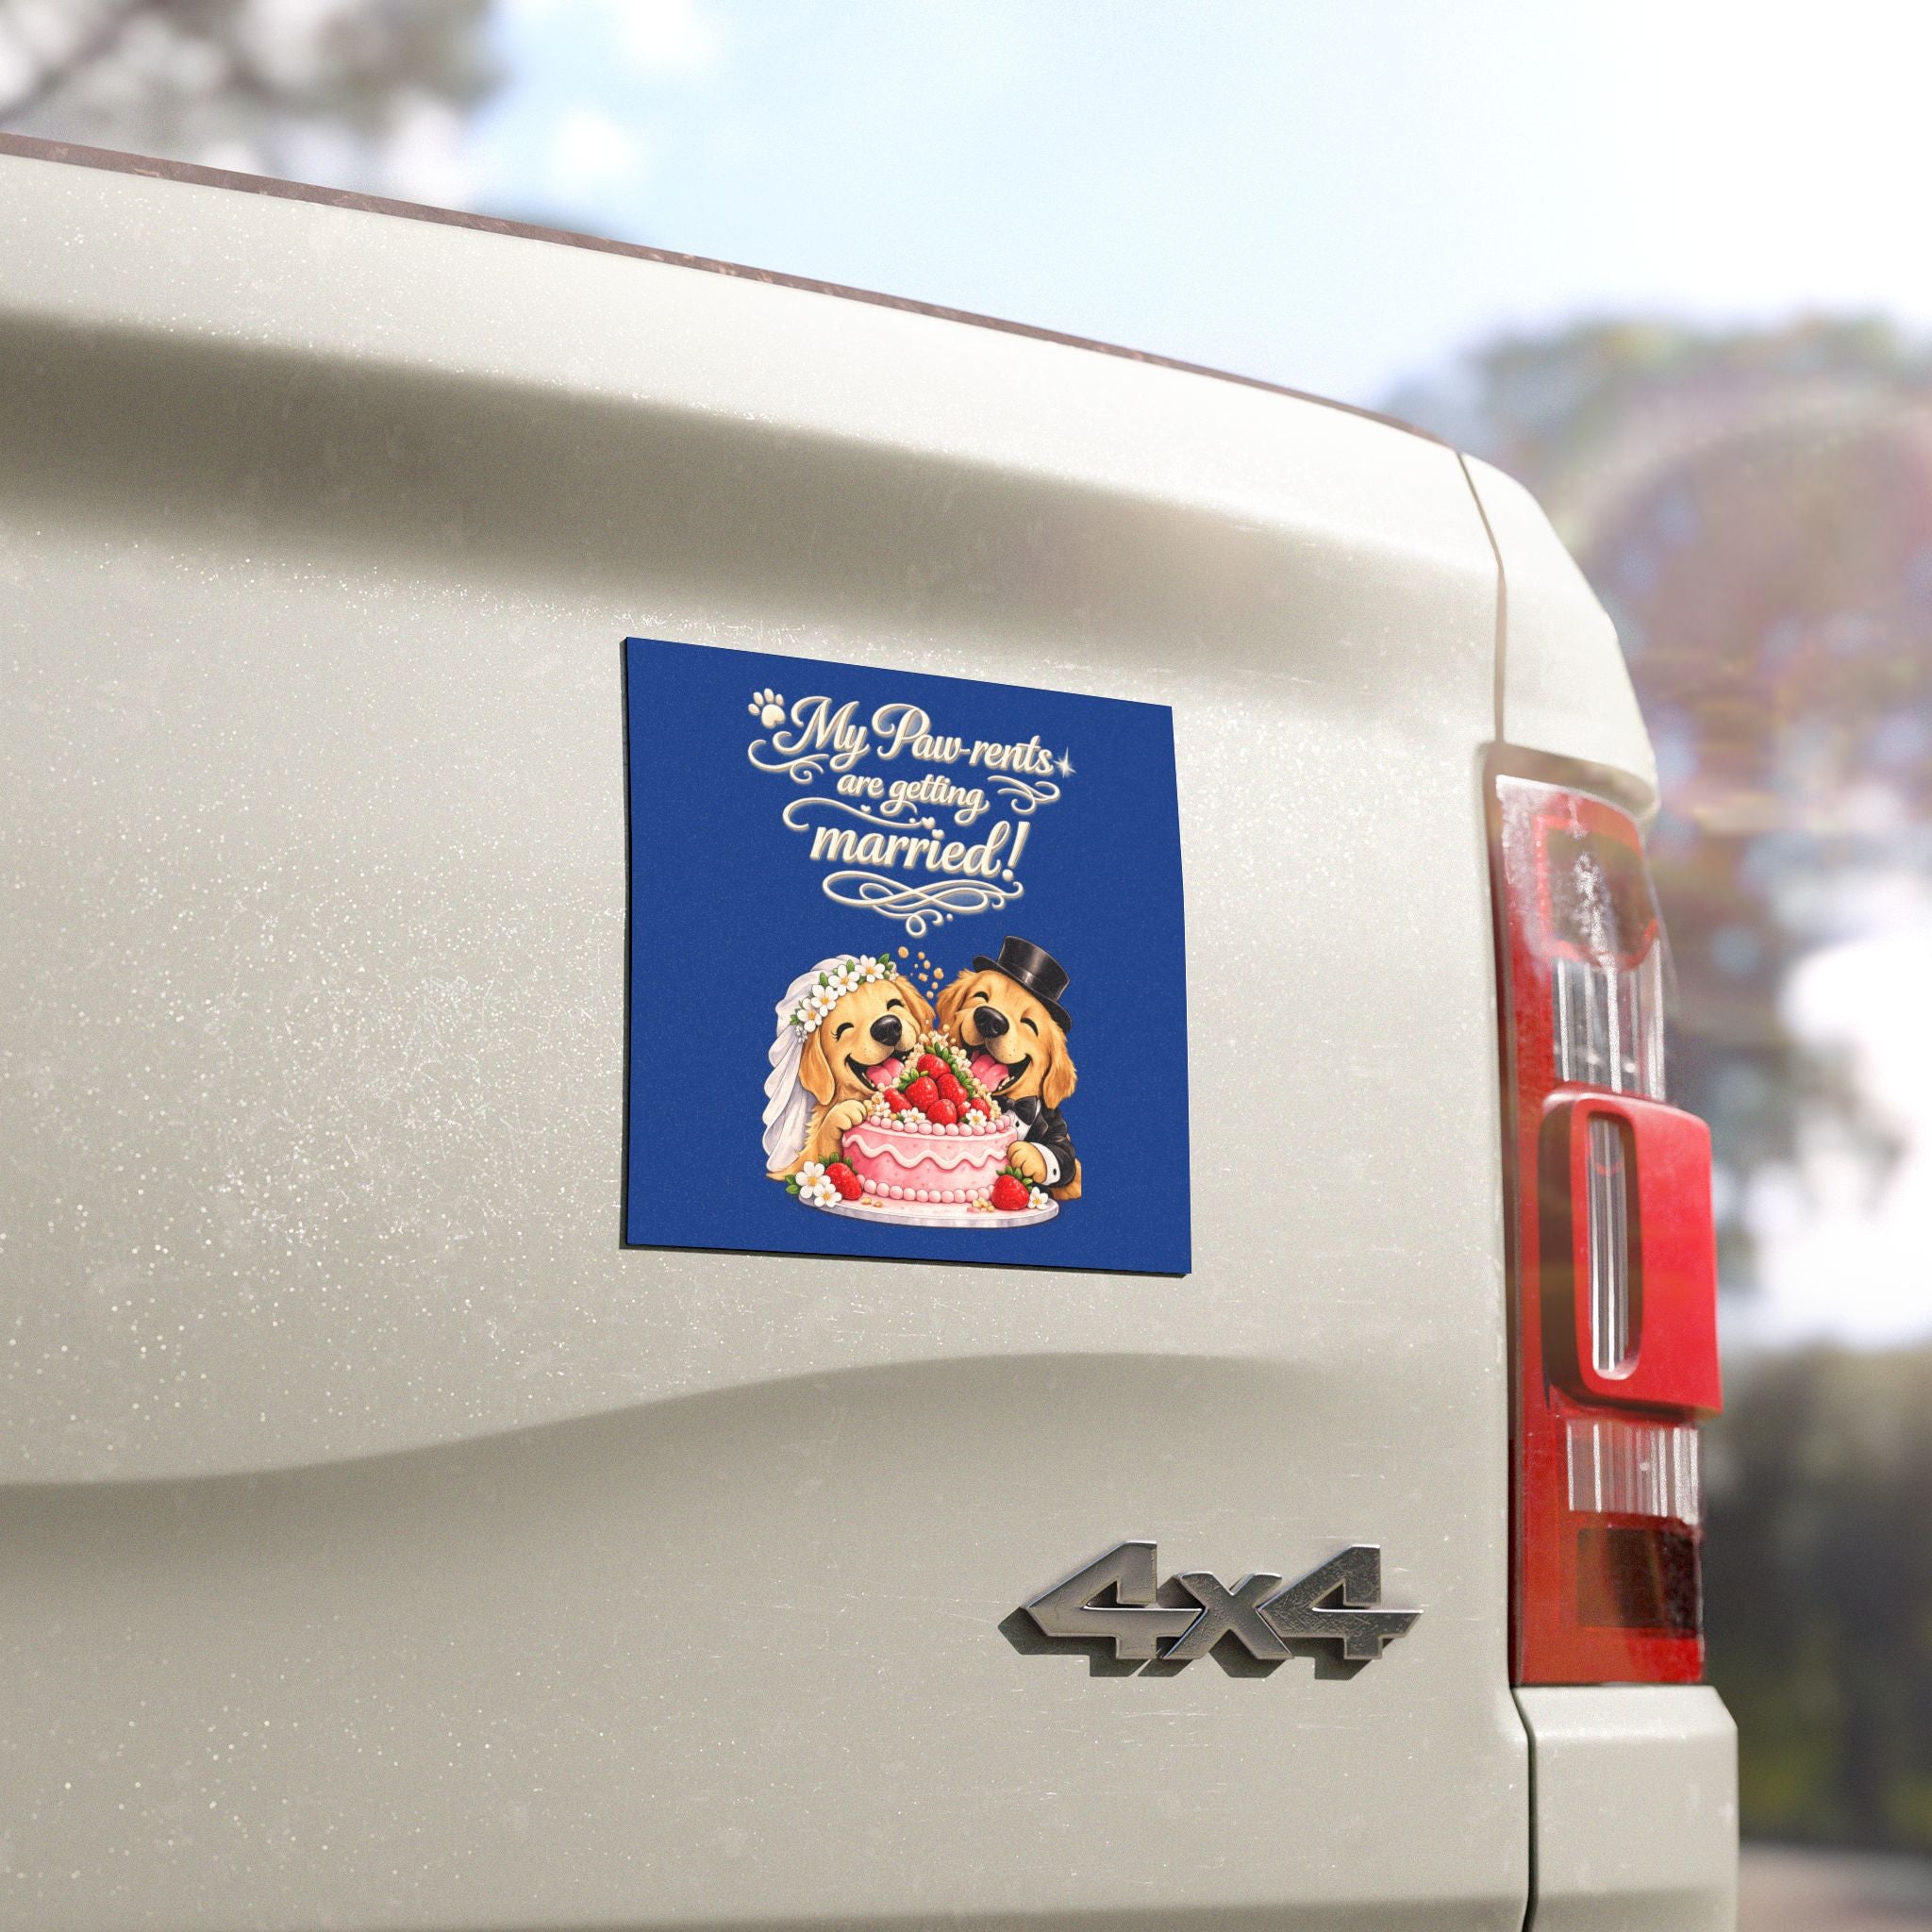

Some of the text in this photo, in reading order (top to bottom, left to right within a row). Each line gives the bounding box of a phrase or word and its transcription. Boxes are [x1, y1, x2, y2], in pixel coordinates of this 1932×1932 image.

[772, 695, 1055, 776] My Paw-rents
[836, 773, 991, 826] are getting
[808, 819, 1031, 882] married!
